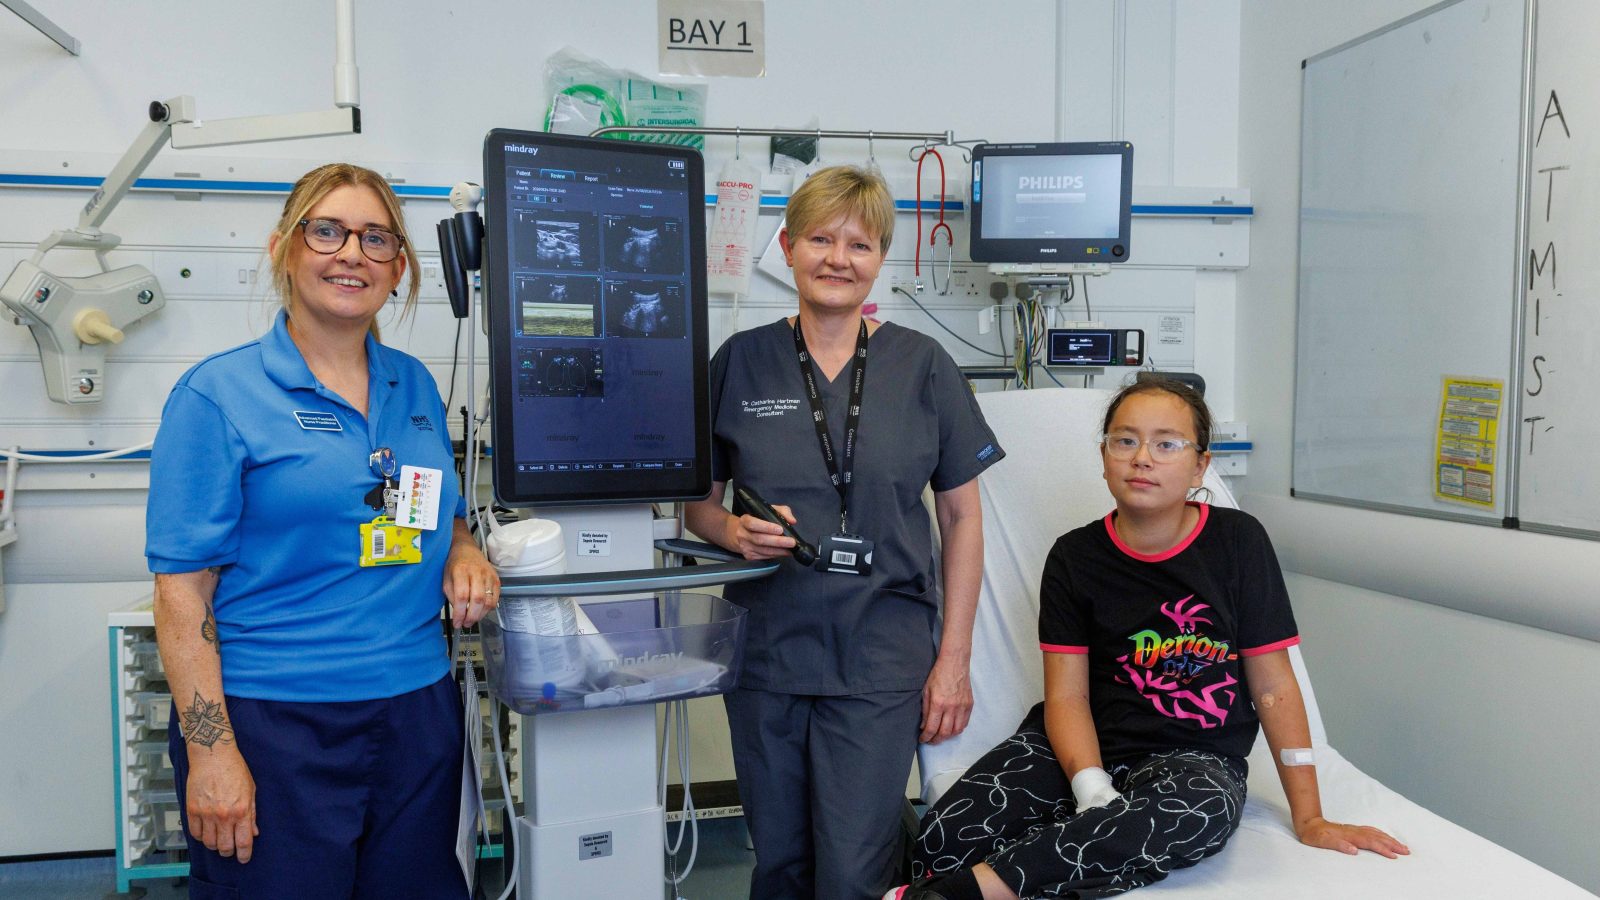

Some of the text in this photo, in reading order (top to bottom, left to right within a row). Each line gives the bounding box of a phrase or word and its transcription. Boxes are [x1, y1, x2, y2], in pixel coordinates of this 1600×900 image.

[669, 18, 752, 46] BAY 1
[647, 118, 697, 126] INTERSURGICAL
[504, 144, 538, 156] mindray
[1018, 176, 1084, 190] PHILIPS
[805, 372, 817, 399] Consultant
[854, 368, 863, 394] Consultant
[743, 405, 773, 413] Emergency
[756, 410, 784, 418] Consultant
[822, 433, 833, 461] Consultant
[846, 428, 854, 458] Consultant
